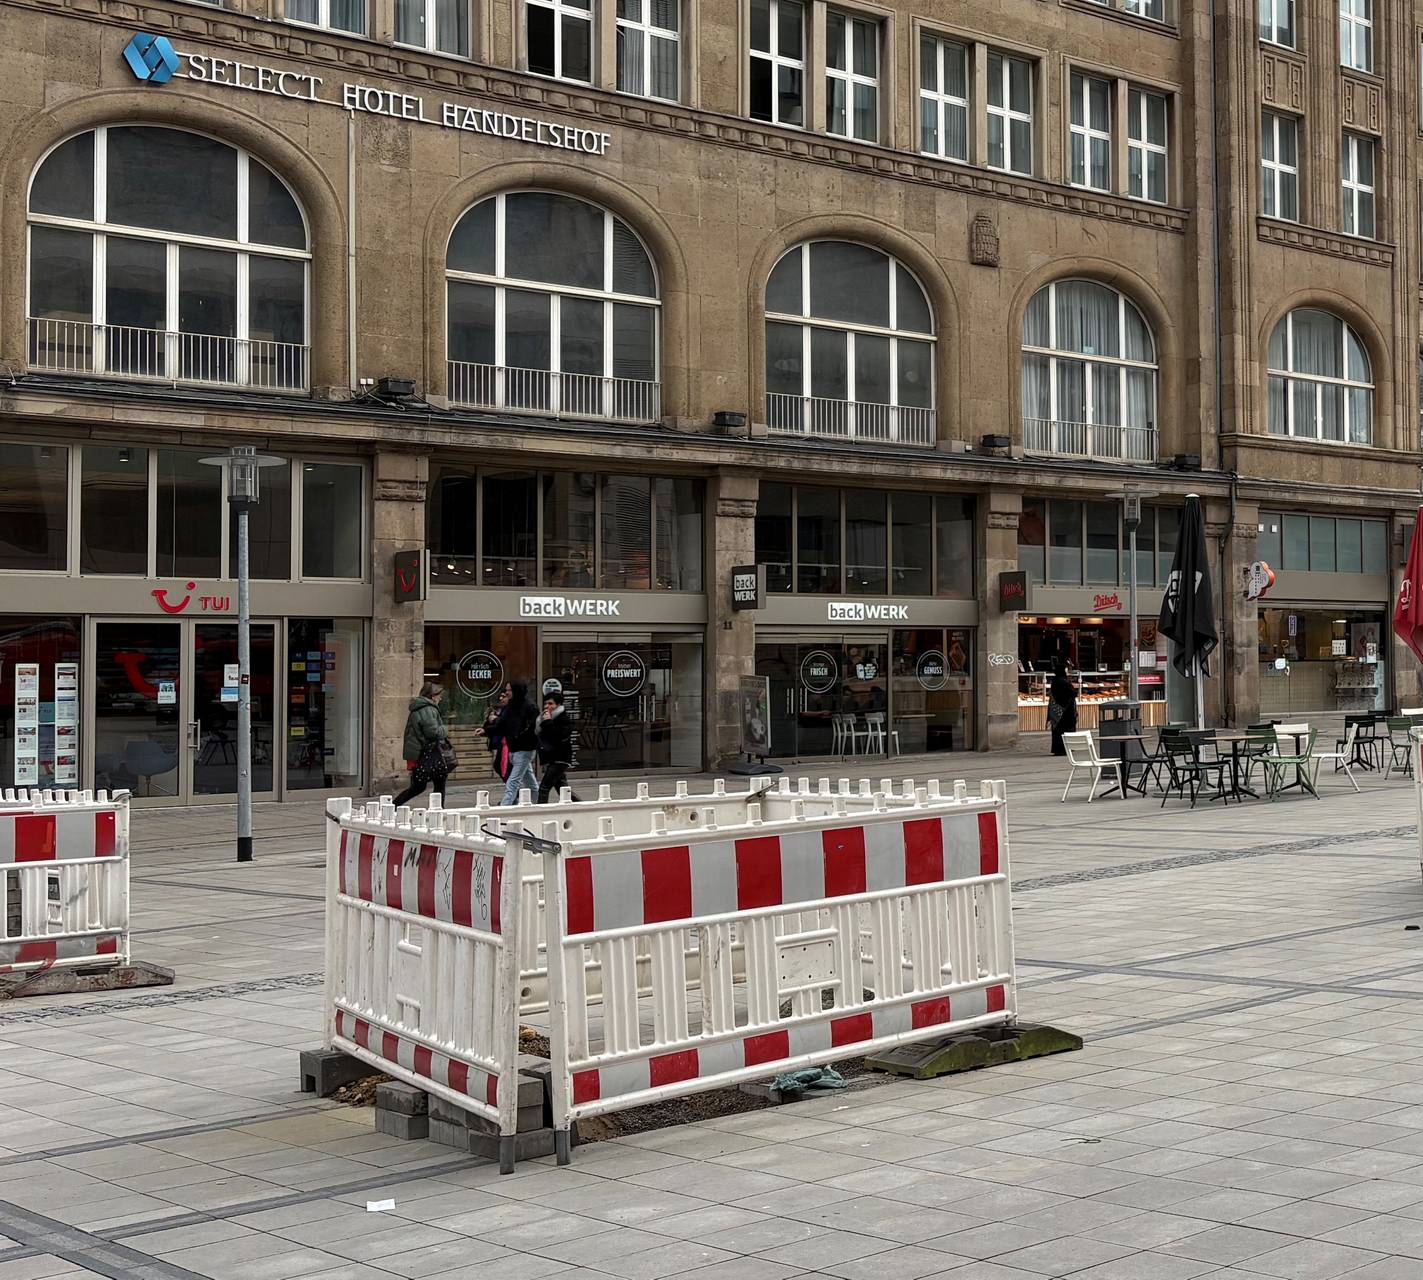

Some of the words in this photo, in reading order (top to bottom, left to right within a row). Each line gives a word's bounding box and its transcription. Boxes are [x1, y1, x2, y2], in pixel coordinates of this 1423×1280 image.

[188, 54, 323, 101] SELECT
[343, 82, 426, 122] HOTEL
[442, 102, 611, 155] HANDELSHOF
[735, 576, 755, 589] back
[734, 590, 756, 601] WERK
[199, 596, 230, 611] TUI
[468, 669, 492, 679] LECKER
[607, 668, 641, 678] PREISWERT
